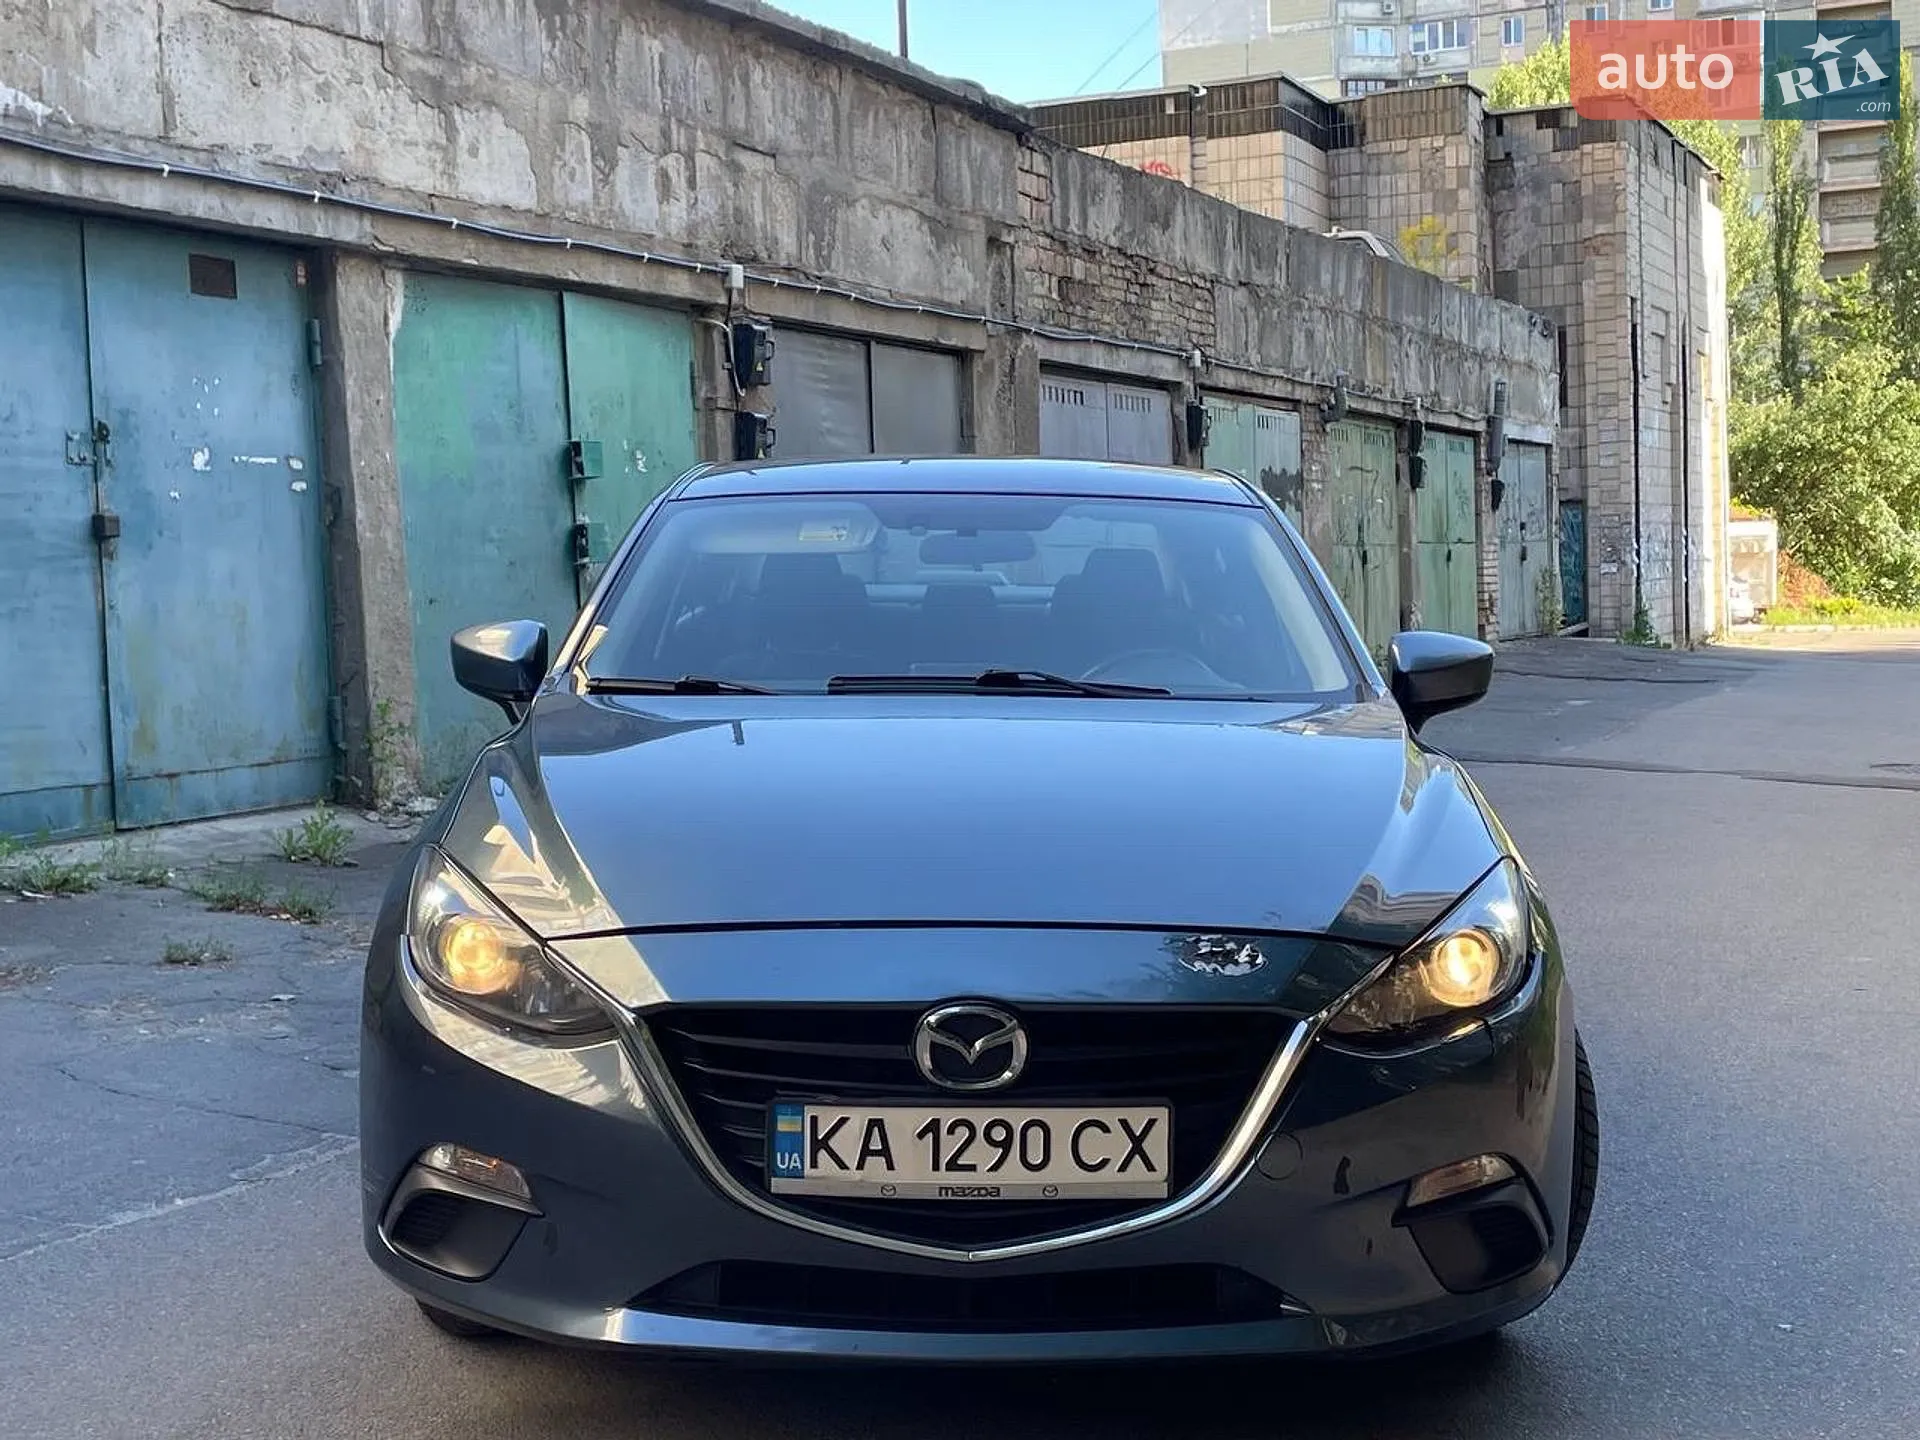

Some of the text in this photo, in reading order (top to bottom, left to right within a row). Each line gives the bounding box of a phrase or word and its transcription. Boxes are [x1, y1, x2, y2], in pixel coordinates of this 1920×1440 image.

[809, 1114, 1159, 1173] KA 1290 CX
[776, 1151, 802, 1170] UA
[938, 1186, 1001, 1198] mazda
